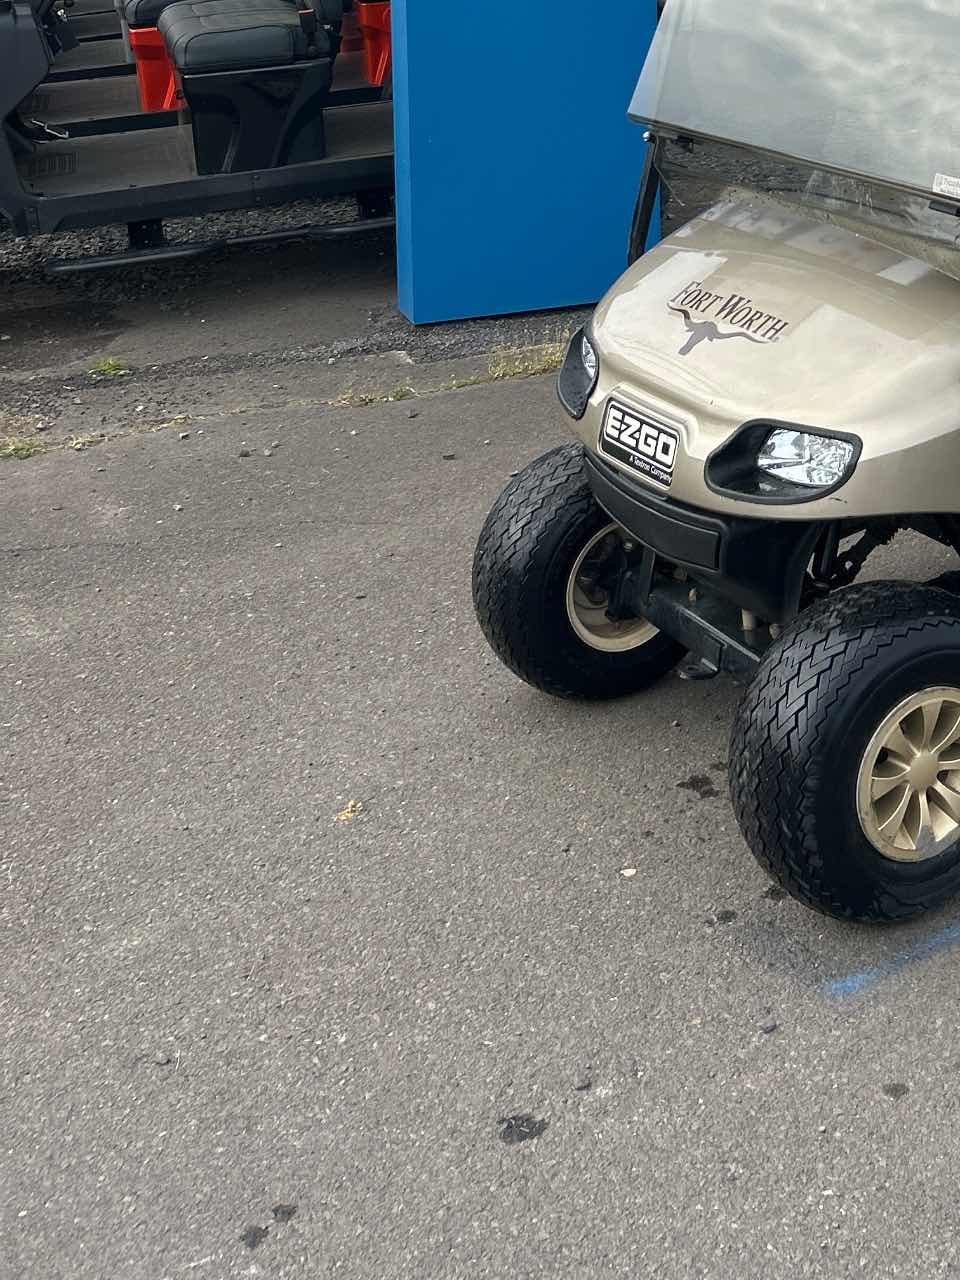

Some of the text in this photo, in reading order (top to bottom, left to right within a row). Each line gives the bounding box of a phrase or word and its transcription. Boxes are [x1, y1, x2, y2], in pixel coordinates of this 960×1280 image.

[670, 281, 789, 340] FORT WORTH
[634, 456, 652, 472] Textron
[650, 465, 673, 484] Company
